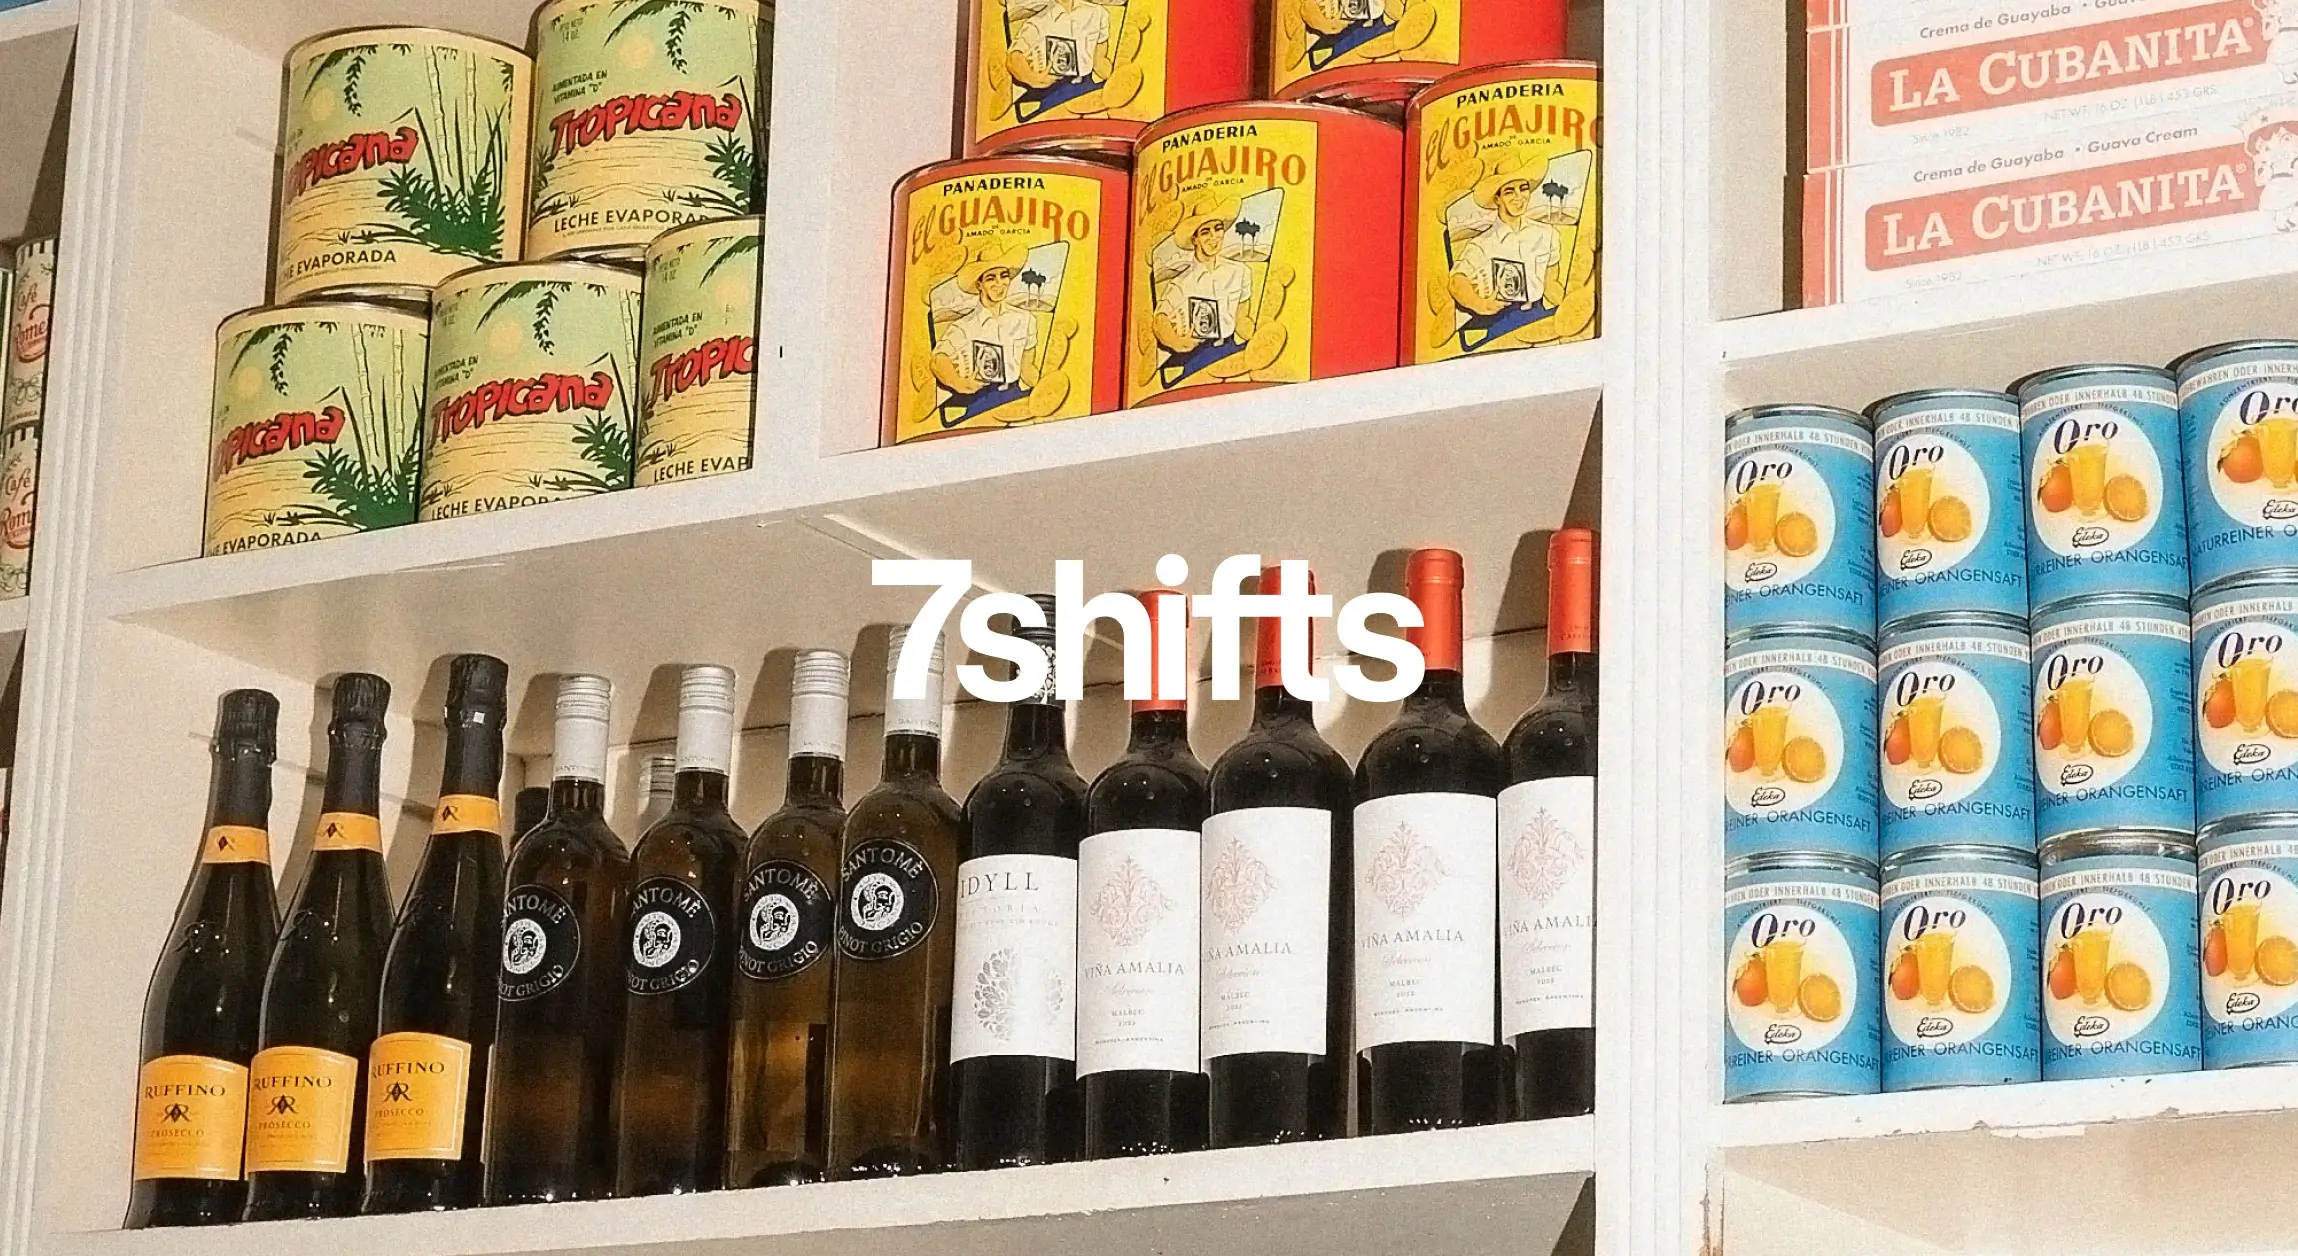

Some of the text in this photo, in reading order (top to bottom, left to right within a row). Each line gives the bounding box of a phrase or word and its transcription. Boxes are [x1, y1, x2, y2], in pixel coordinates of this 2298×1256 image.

[1919, 5, 2071, 39] Crema de Guayaba
[1889, 18, 2252, 112] LA CUBANITA
[1456, 83, 1565, 109] PANADERIA
[1162, 124, 1258, 153] PANADERIA
[1481, 137, 1551, 150] AMADO GARCIA
[1913, 125, 2199, 184] Crema de Guayaba Guava Cream
[1158, 144, 1306, 193] GUAJIRO
[943, 176, 1046, 197] PANADERIA
[1181, 177, 1245, 193] AMADO GARCIA
[938, 195, 1090, 242] GUAJIRO
[1883, 163, 2246, 257] LA CUBANITA
[554, 211, 599, 233] LECHE
[965, 227, 1031, 238] AMADO GARCIA
[296, 249, 397, 276] EVAPORADA
[2233, 364, 2258, 378] ODER
[2074, 389, 2128, 402] INNERHALB
[2132, 389, 2143, 400] 48
[1905, 411, 1954, 428] INNERHALB
[1960, 411, 1972, 423] 48
[1754, 431, 1804, 443] INNERHALB
[1809, 431, 1820, 441] 48
[2054, 419, 2119, 455] Oro
[653, 461, 694, 484] LECHE
[1889, 445, 1944, 481] Oro
[1736, 459, 1793, 495] Oro
[1915, 568, 2022, 588] ORANGENSAFT
[1759, 582, 1864, 606] ORANGENSAFT
[2238, 600, 2293, 615] INNERHALB
[2063, 622, 2114, 637] INNERHALB
[1761, 652, 1812, 665] INNERHALB
[1817, 653, 1828, 664] 48
[1914, 640, 1966, 655] INNERHALB
[1971, 640, 1982, 652] 48
[2218, 632, 2283, 669] Oro
[2047, 654, 2104, 691] Oro
[1740, 680, 1801, 715] Oro
[1896, 672, 1956, 707] Oro
[2075, 785, 2188, 803] ORANGENSAFT
[1767, 810, 1871, 833] ORANGENSAFT
[1924, 800, 2030, 822] ORANGENSAFT
[2229, 844, 2283, 861] INNERHALB
[960, 871, 1039, 899] IDYLL
[1924, 875, 1978, 890] INNERHALB
[1982, 876, 1994, 888] 48
[2079, 871, 2134, 886] INNERHALB
[1774, 884, 1826, 897] INNERHALB
[1831, 887, 1843, 898] 48
[2213, 877, 2271, 915] Oro
[1751, 912, 1816, 949] Oro
[1903, 905, 1966, 941] Oro
[2061, 902, 2122, 940] Oro
[871, 920, 923, 954] GRIGIO
[1393, 928, 1465, 944] AMALIA
[767, 940, 819, 973] GRIGIO
[1225, 941, 1292, 959] AMALIA
[649, 958, 700, 990] GRIGIO
[1116, 961, 1185, 976] AMALIA
[516, 964, 564, 997] GRIGIO
[1934, 1041, 2038, 1062] ORANGENSAFT
[2090, 1040, 2200, 1063] ORANGENSAFT
[372, 1061, 445, 1078] RUFFINO
[145, 1084, 226, 1099] RUFFINO
[254, 1075, 332, 1091] RUFFINO
